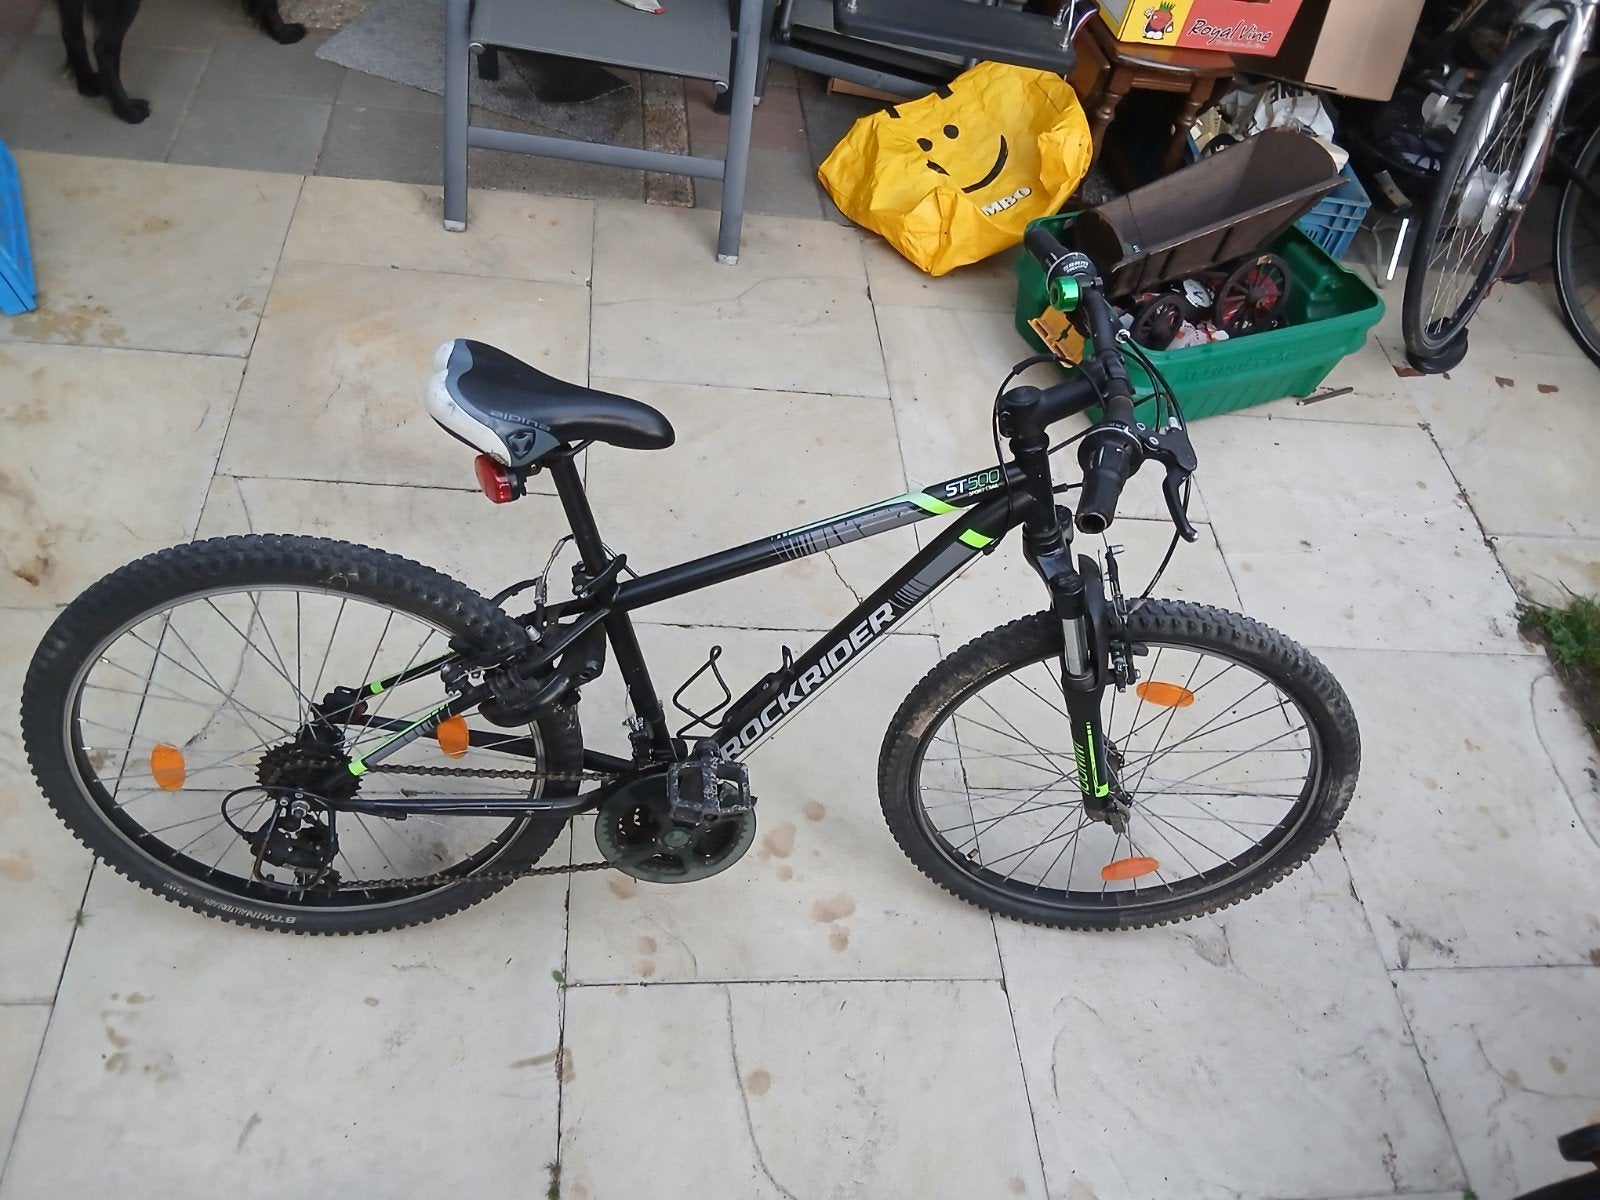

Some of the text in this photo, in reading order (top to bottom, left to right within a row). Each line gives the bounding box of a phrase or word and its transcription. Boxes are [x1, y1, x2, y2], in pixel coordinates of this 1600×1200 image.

[1187, 18, 1244, 45] Royal
[1239, 24, 1273, 43] Vine
[719, 601, 897, 762] ROCKRIDER
